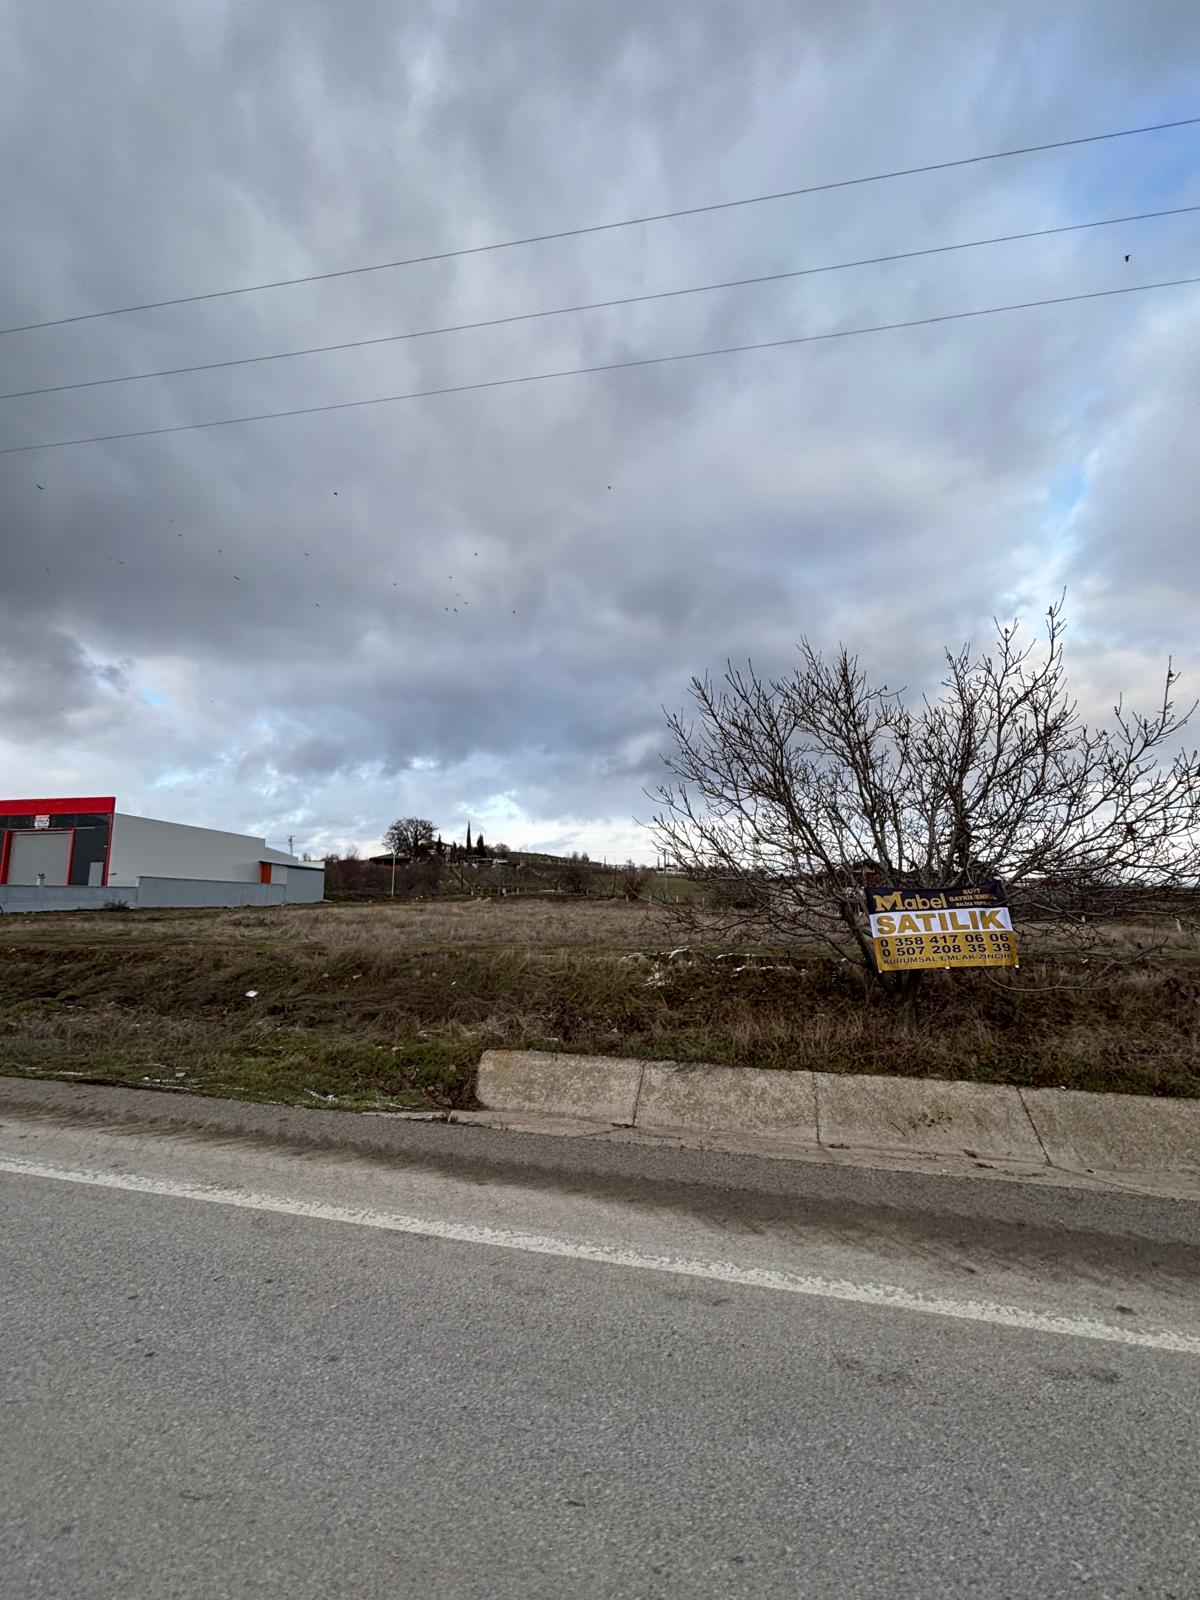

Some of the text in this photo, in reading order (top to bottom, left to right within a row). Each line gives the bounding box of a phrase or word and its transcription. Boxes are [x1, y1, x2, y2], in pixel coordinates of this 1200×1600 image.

[873, 891, 948, 911] Mabel
[876, 910, 1006, 935] SATILIK
[880, 933, 1009, 948] 0 358 417 06 06
[882, 942, 1011, 958] 0 507 208 35 39
[883, 956, 938, 965] KURUMSAL
